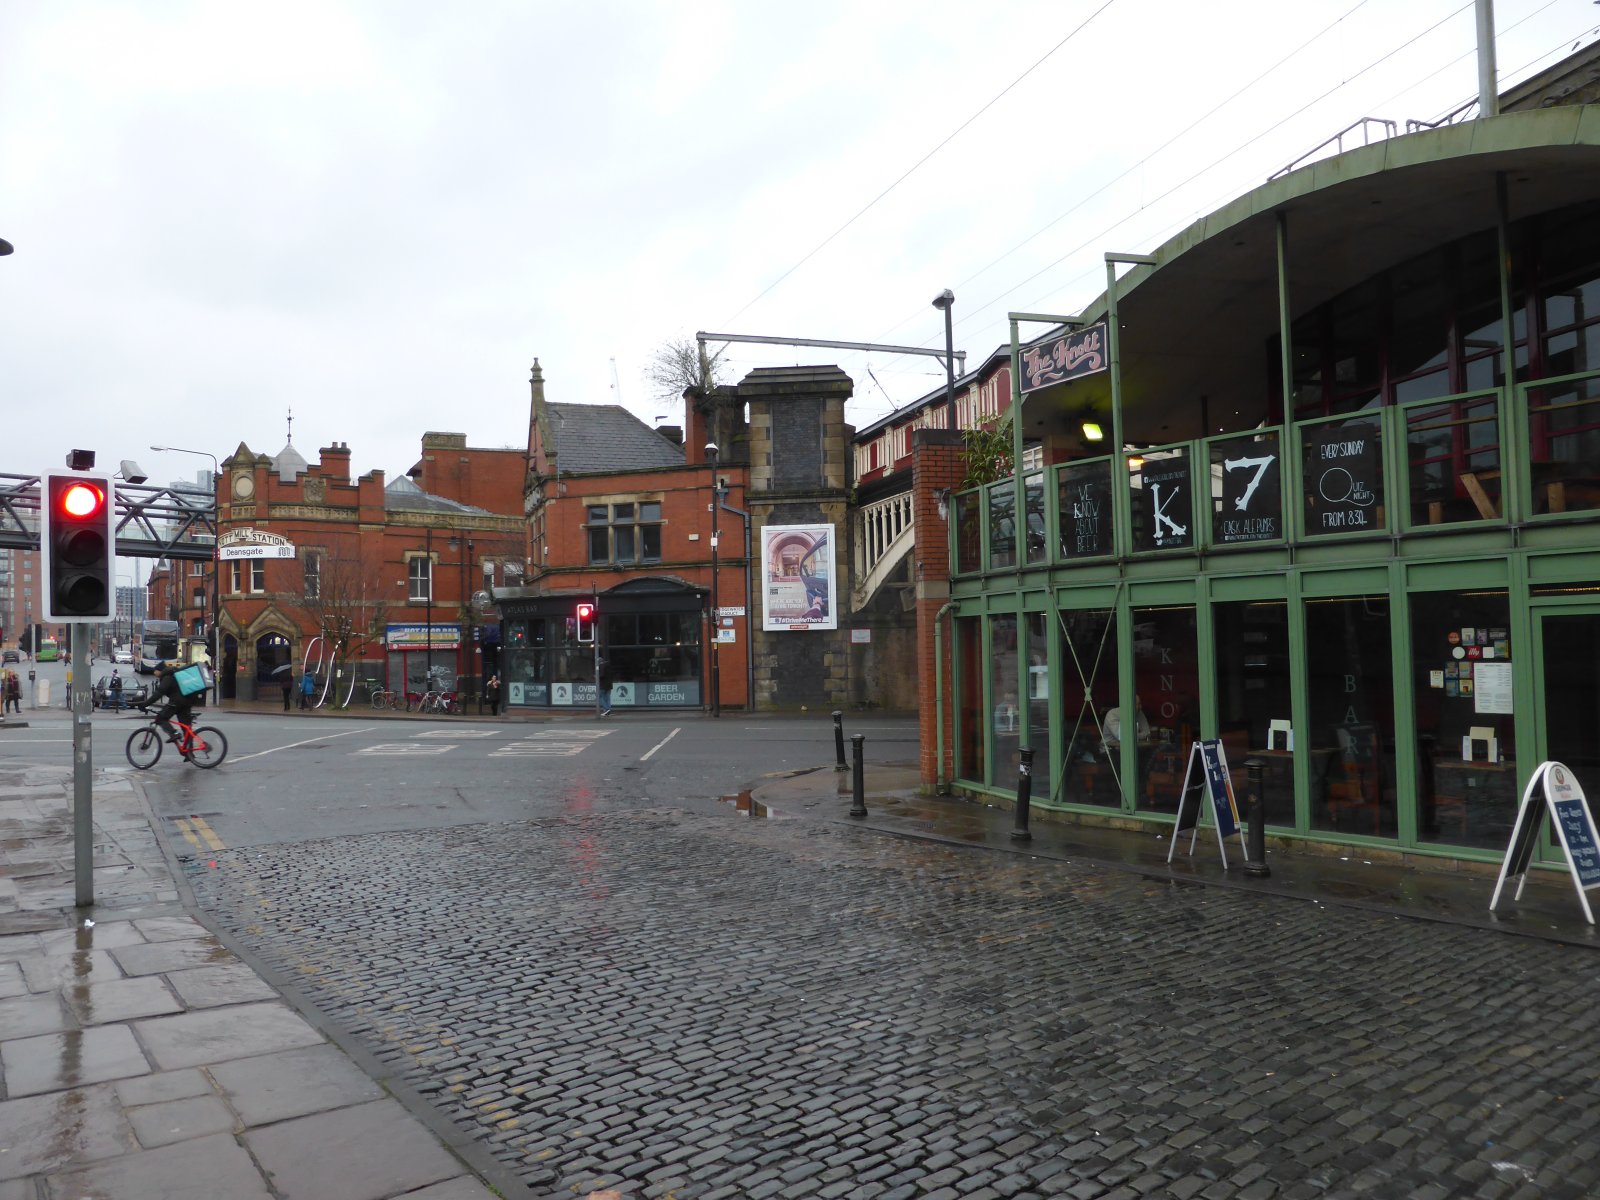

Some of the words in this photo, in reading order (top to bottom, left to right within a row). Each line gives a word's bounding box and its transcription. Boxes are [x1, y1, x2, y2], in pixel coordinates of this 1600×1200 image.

[1023, 347, 1055, 384] The
[1053, 331, 1101, 370] Knott
[1320, 442, 1339, 459] EVERY
[1340, 440, 1364, 457] SUNDAY
[1224, 454, 1276, 512] 7
[1078, 484, 1093, 501] WE
[1353, 491, 1370, 500] NIGHT
[1073, 501, 1100, 518] KNOW
[1150, 483, 1187, 538] K
[1076, 517, 1099, 534] ABOUT
[1223, 520, 1240, 534] CASK
[1243, 518, 1255, 534] ALE
[1256, 517, 1275, 532] PUMPS
[1322, 511, 1345, 527] FROM
[234, 530, 249, 538] MILL
[252, 534, 285, 546] STATION
[1077, 535, 1097, 552] BEER
[226, 548, 263, 556] Deansgate
[1468, 647, 1480, 656] illy
[654, 684, 678, 692] BEER
[573, 693, 585, 701] 300
[648, 693, 685, 701] GARDEN
